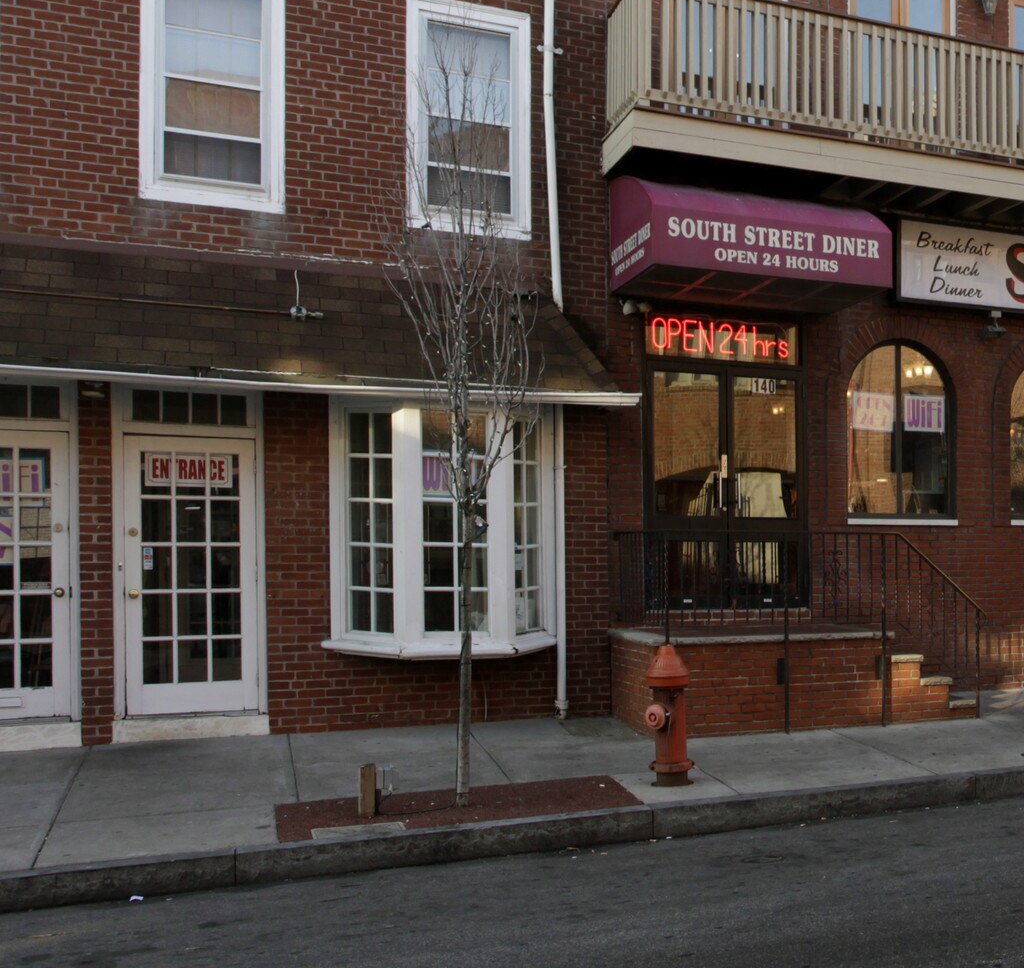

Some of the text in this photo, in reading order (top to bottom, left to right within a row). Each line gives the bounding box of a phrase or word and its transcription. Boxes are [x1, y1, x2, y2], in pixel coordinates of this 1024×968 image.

[611, 222, 651, 266] SOUTH STREET DINER
[668, 216, 880, 259] SOUTH STREET DINER
[916, 231, 994, 256] Breakfast
[615, 261, 626, 276] OPEN
[630, 247, 645, 265] HOURS
[714, 247, 839, 273] OPEN 24 HOURS
[933, 255, 980, 277] Lunch
[930, 276, 983, 299] Dinner
[652, 317, 789, 359] OPEN 24 hrs
[754, 378, 775, 394] 140
[907, 398, 942, 428] WiFi
[0, 464, 39, 501] iFi
[152, 458, 225, 481] ENTRANCE
